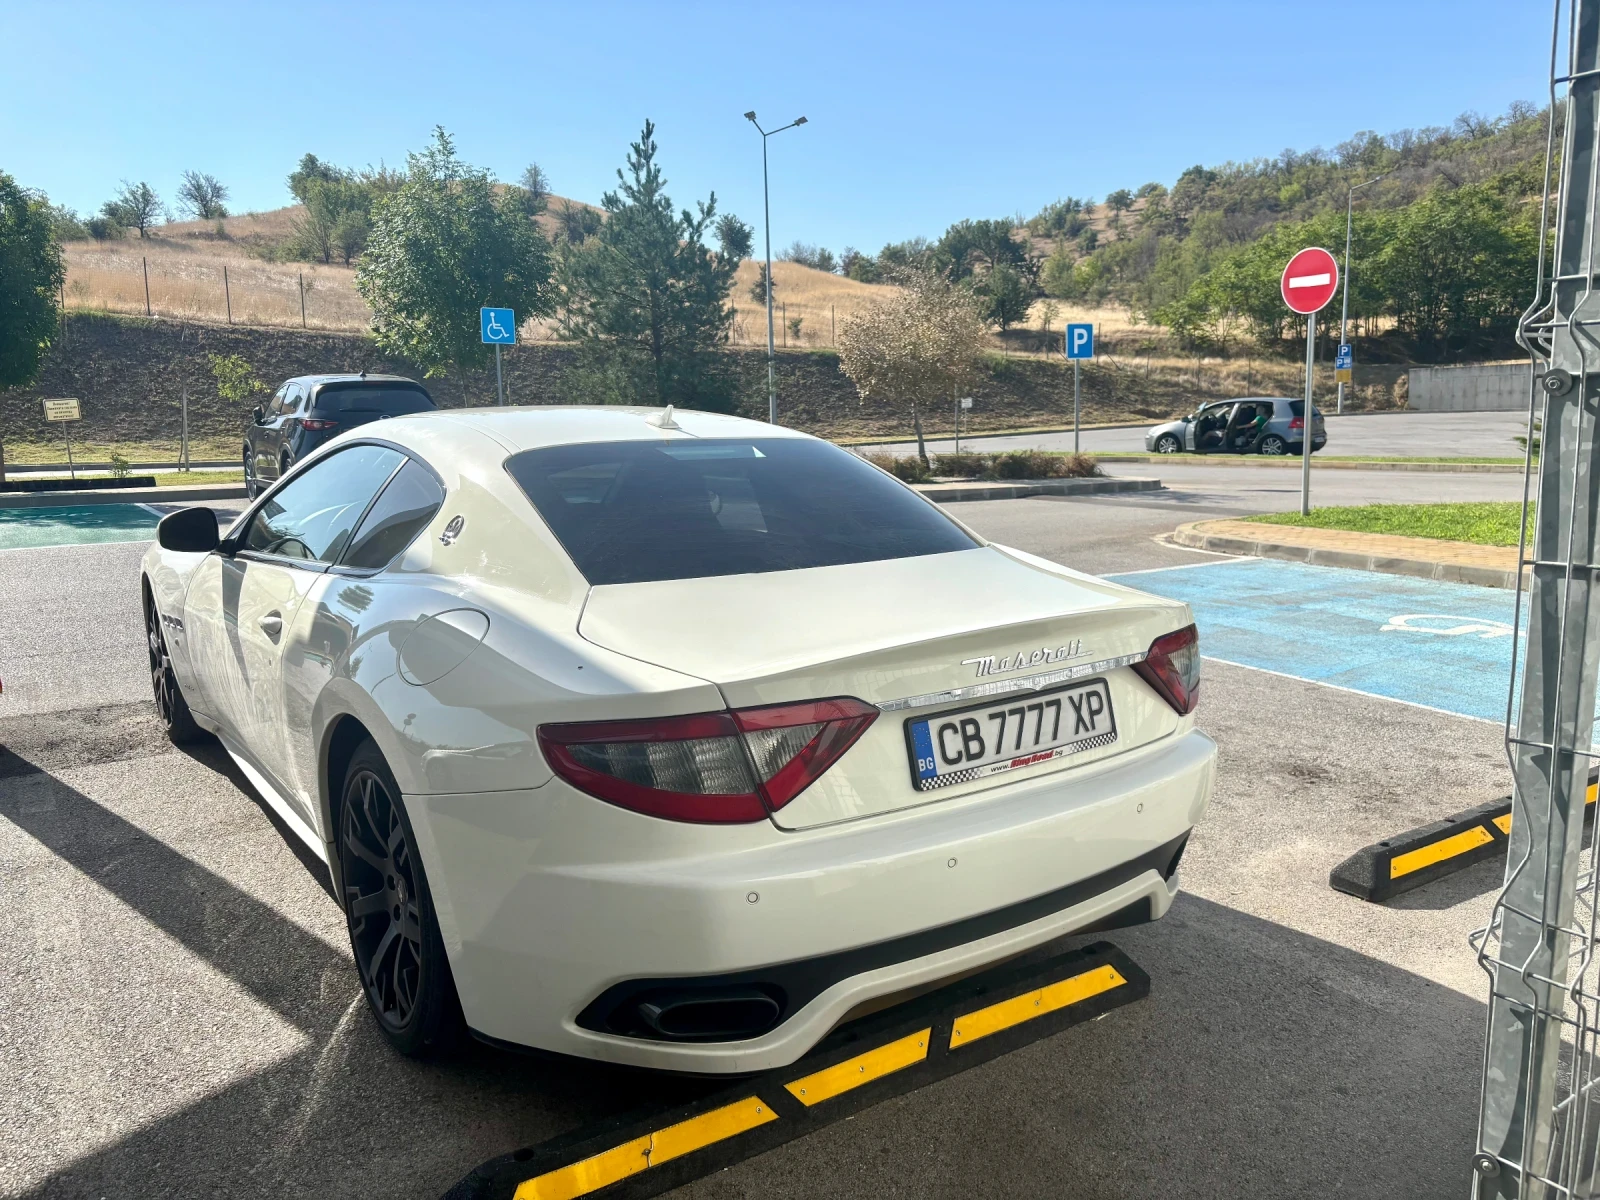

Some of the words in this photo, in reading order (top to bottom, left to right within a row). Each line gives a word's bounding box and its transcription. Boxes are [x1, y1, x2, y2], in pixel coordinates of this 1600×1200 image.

[1073, 328, 1088, 354] P
[1341, 346, 1348, 355] P
[960, 638, 1094, 677] Maserati
[937, 717, 986, 766] CB
[988, 698, 1062, 755] 7777
[1067, 690, 1104, 735] XP
[917, 757, 934, 772] BG
